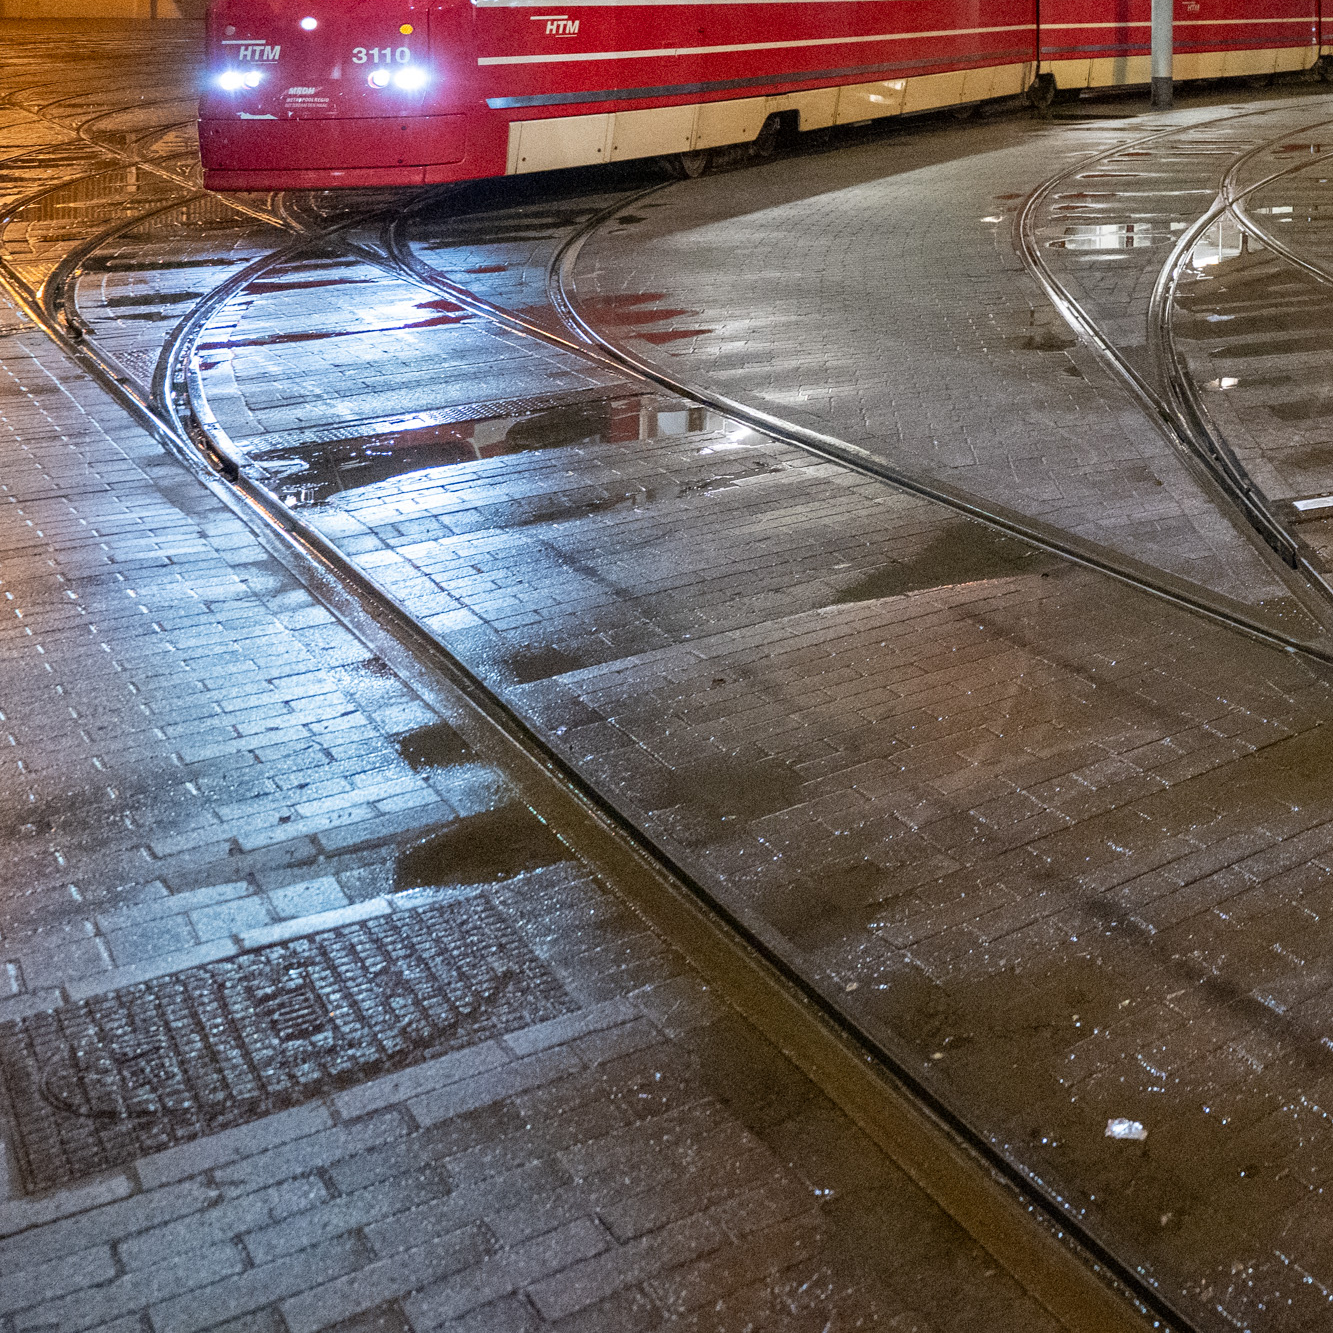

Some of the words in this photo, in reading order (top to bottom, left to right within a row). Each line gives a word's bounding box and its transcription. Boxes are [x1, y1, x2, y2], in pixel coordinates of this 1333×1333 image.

[546, 20, 579, 34] HTM
[239, 46, 281, 61] HTM
[352, 47, 411, 64] 3110
